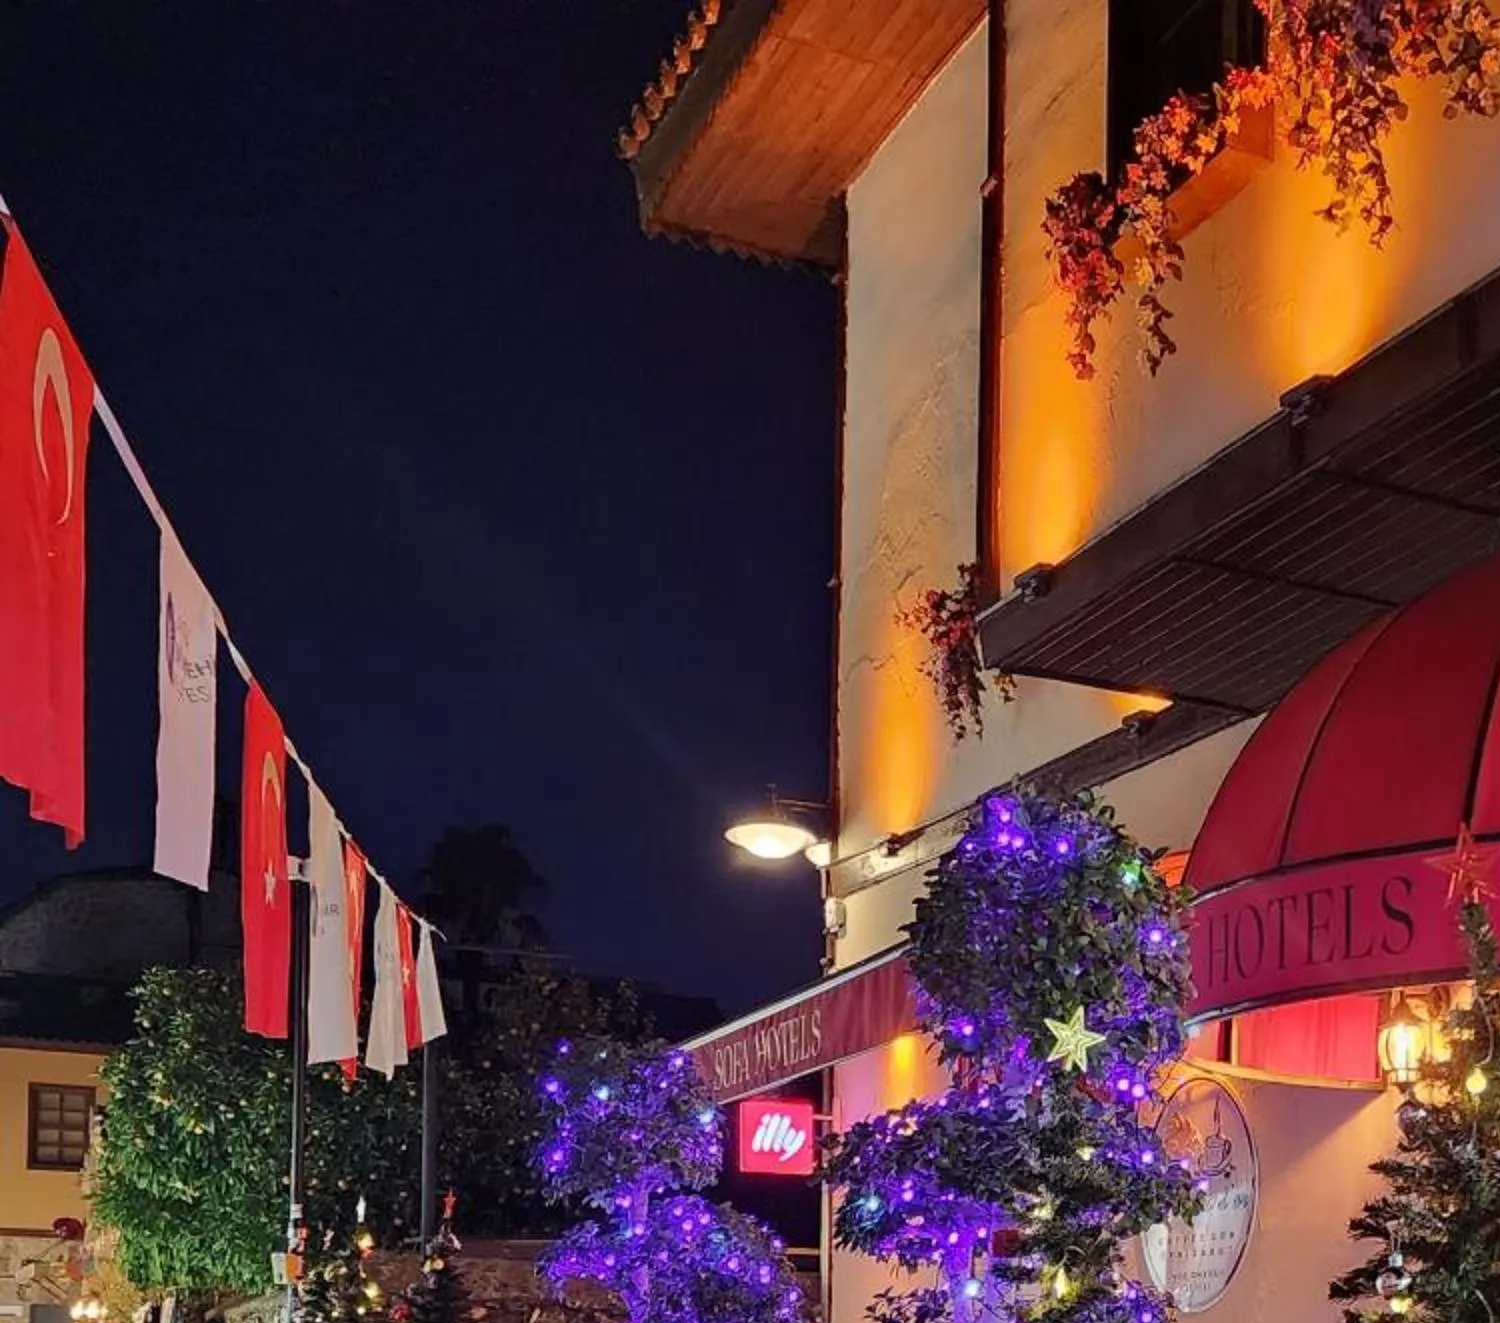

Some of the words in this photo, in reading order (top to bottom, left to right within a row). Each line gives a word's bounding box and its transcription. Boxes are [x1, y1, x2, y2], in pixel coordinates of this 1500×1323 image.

[1205, 875, 1415, 990] HOTELS
[713, 1038, 751, 1092] SOFA
[755, 1010, 822, 1076] HOTELS
[752, 1112, 806, 1162] illy
